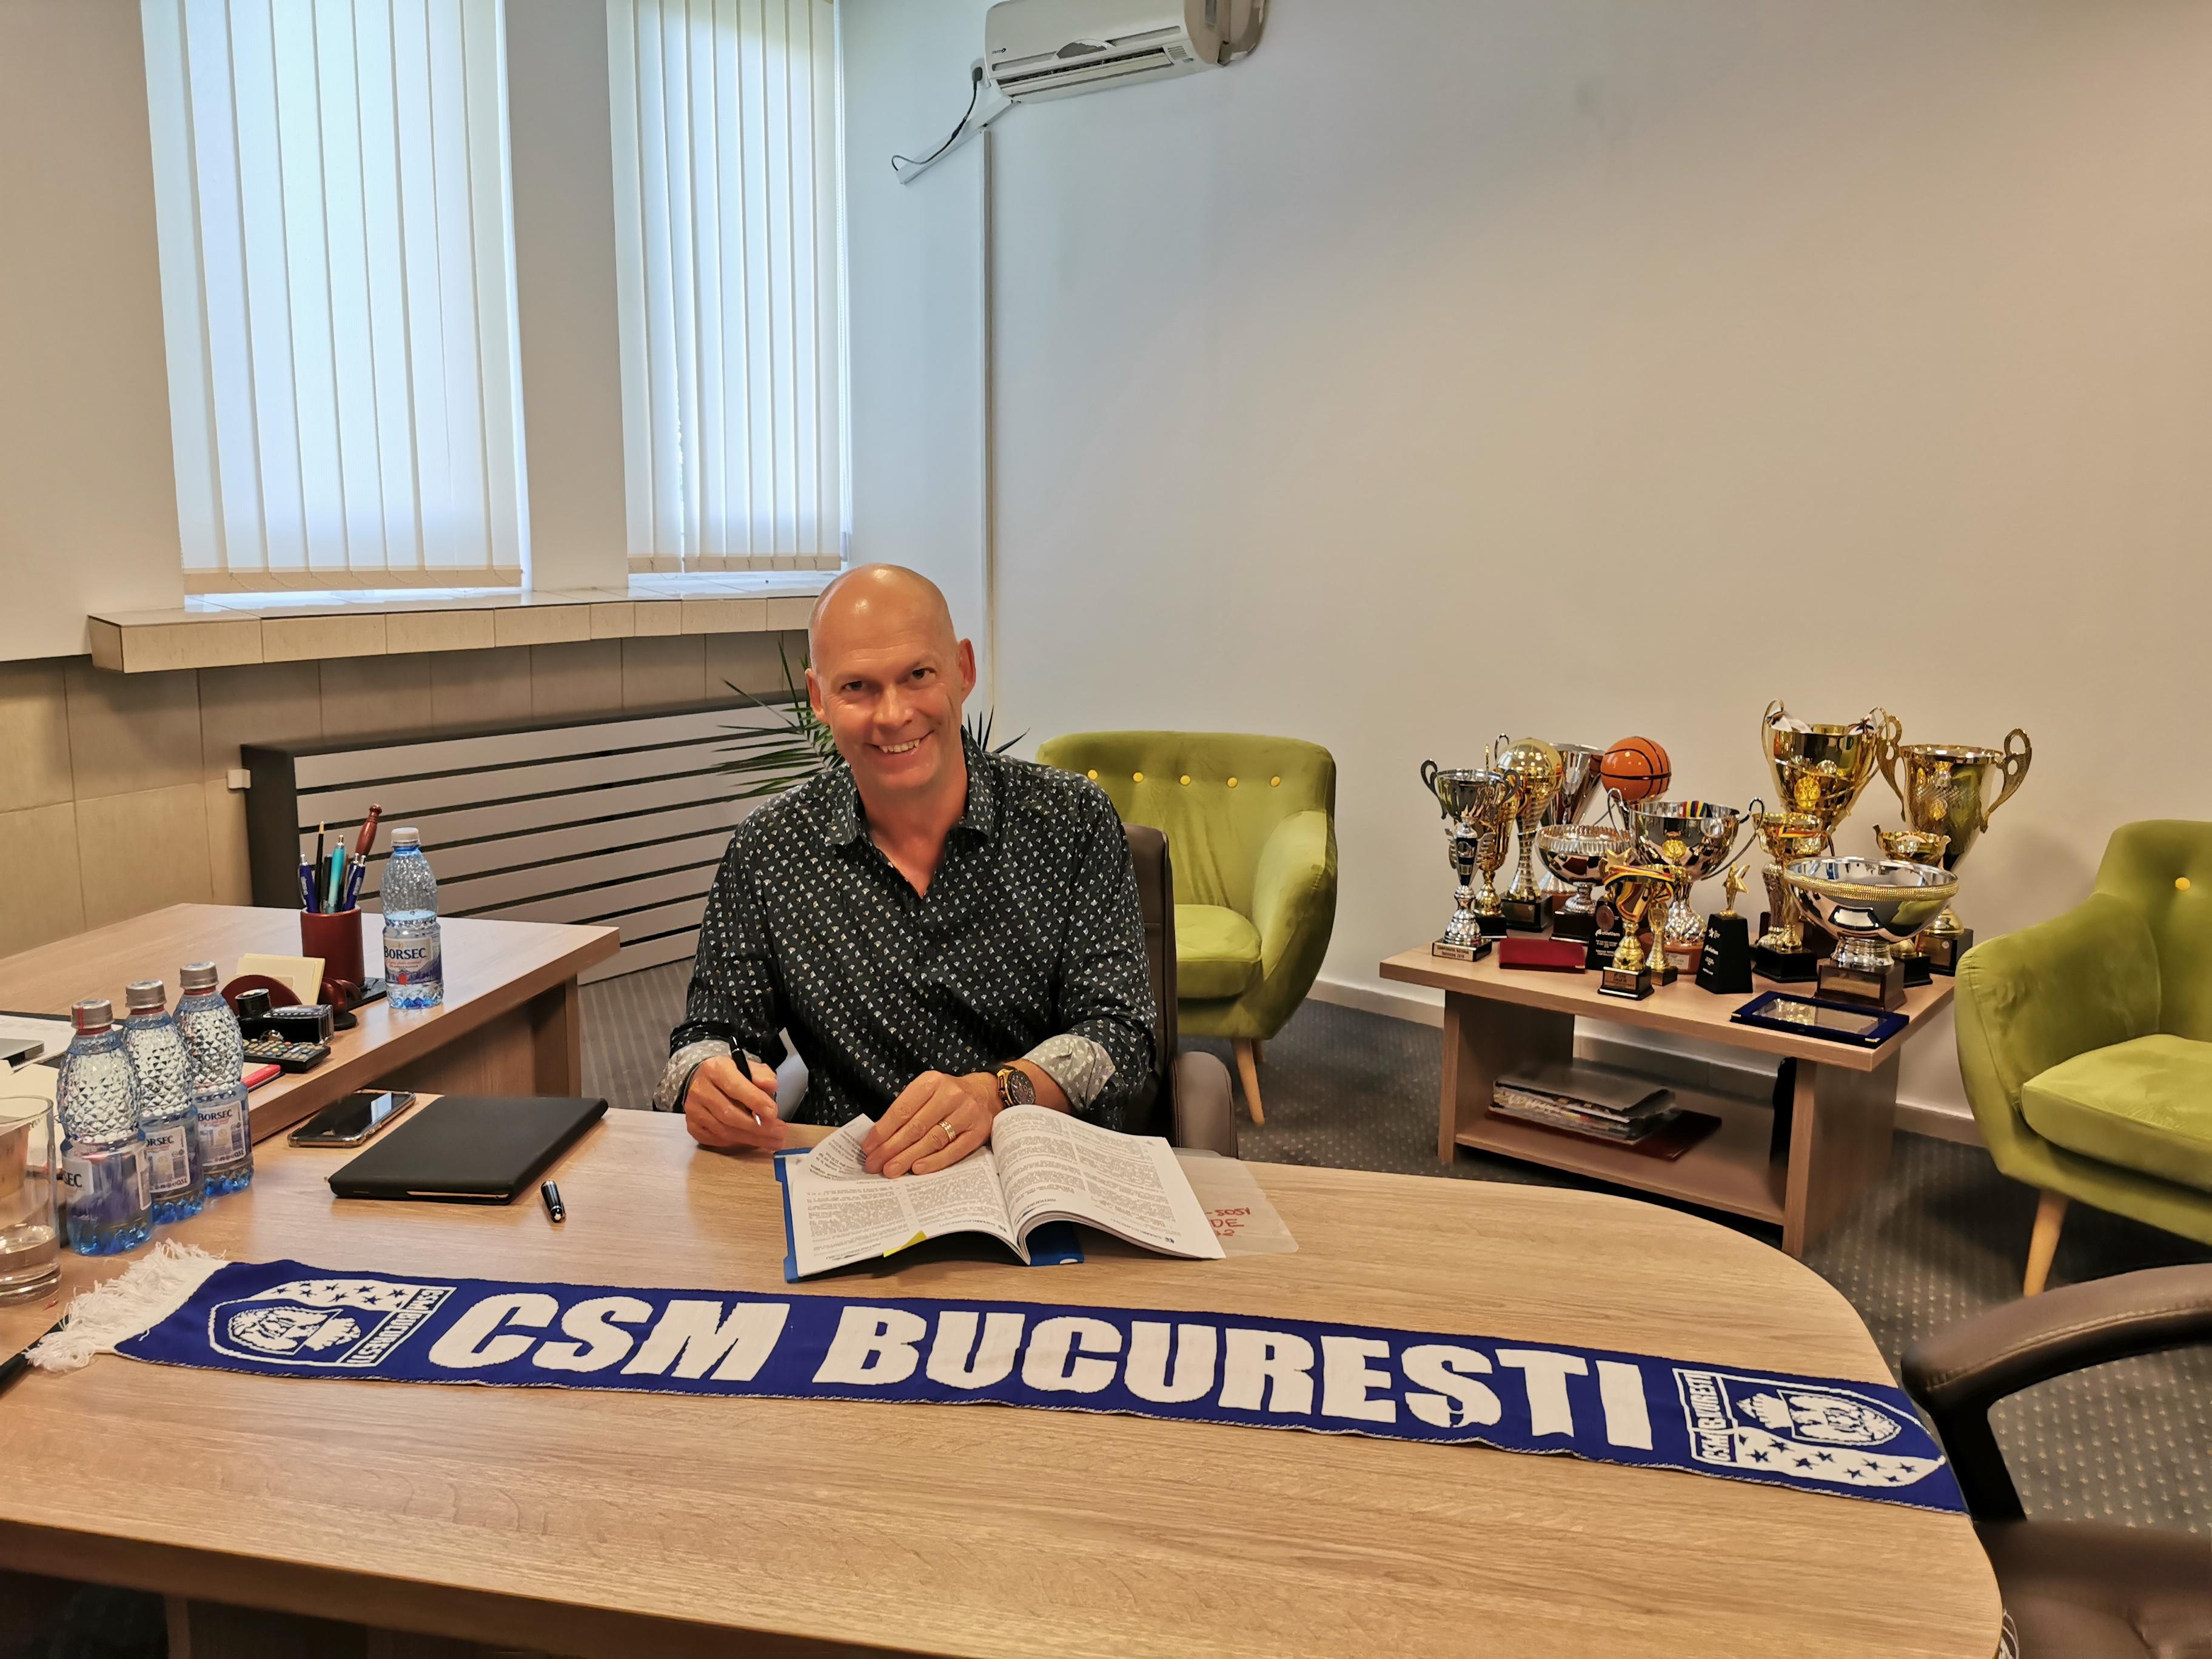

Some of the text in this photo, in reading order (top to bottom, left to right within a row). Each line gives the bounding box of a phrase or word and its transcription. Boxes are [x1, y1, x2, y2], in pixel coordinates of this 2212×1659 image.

[384, 946, 427, 959] BORSEC
[198, 1109, 233, 1121] BORSEC
[428, 1293, 1654, 1451] CSM BUCURESTI
